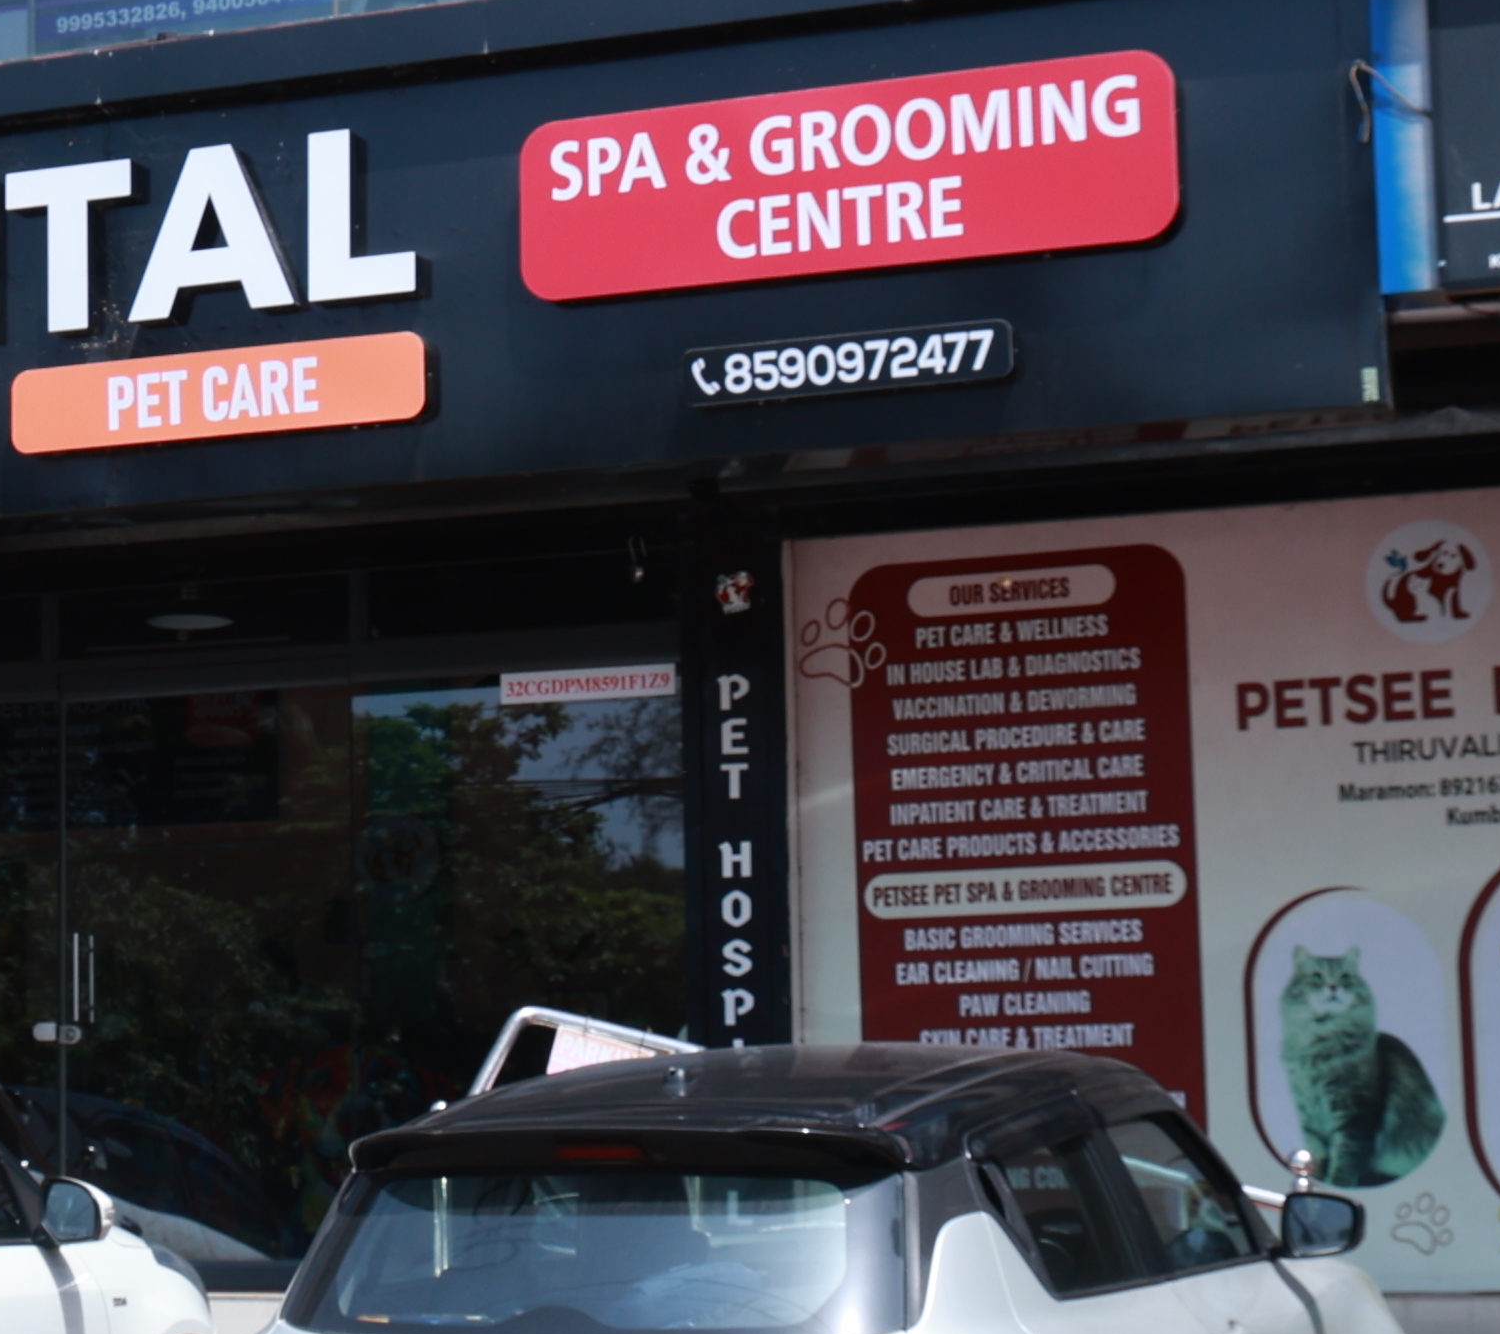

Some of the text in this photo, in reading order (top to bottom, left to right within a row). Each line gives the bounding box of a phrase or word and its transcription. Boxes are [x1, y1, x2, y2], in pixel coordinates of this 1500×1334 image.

[549, 74, 1142, 202] SPA & GROOMING
[715, 175, 965, 260] CENTRE
[723, 328, 995, 395] 8590972477
[106, 355, 319, 431] PET CARE
[949, 576, 1071, 607] OUR SERVICES
[915, 613, 1110, 649] PET CARE WELLNESS
[909, 646, 1143, 685] HOUSE LAB DIAGNOSTICS
[893, 682, 1138, 721] VACCINATION DEWORMING
[1235, 667, 1456, 731] PETSEE
[716, 672, 751, 800] PET
[887, 718, 1147, 757] SURGICAL PROCEDURE CARE
[891, 754, 1146, 792] EMERGENCY CRITICAL CARE
[889, 789, 1149, 826] INPATIENT CARE TREATMENT
[862, 823, 1182, 864] PET CARE PRODUCTS ACCESSORIES
[873, 871, 1175, 908] PETSEE PET SPA GROOMING CENTRE
[904, 918, 1144, 952] BASIC GROOMING SERVICES
[895, 952, 1156, 986] EAR CLEANING NAIL CUTTING
[959, 989, 1092, 1018] PAW CLEANING
[1032, 1021, 1136, 1050] TREATMENT
